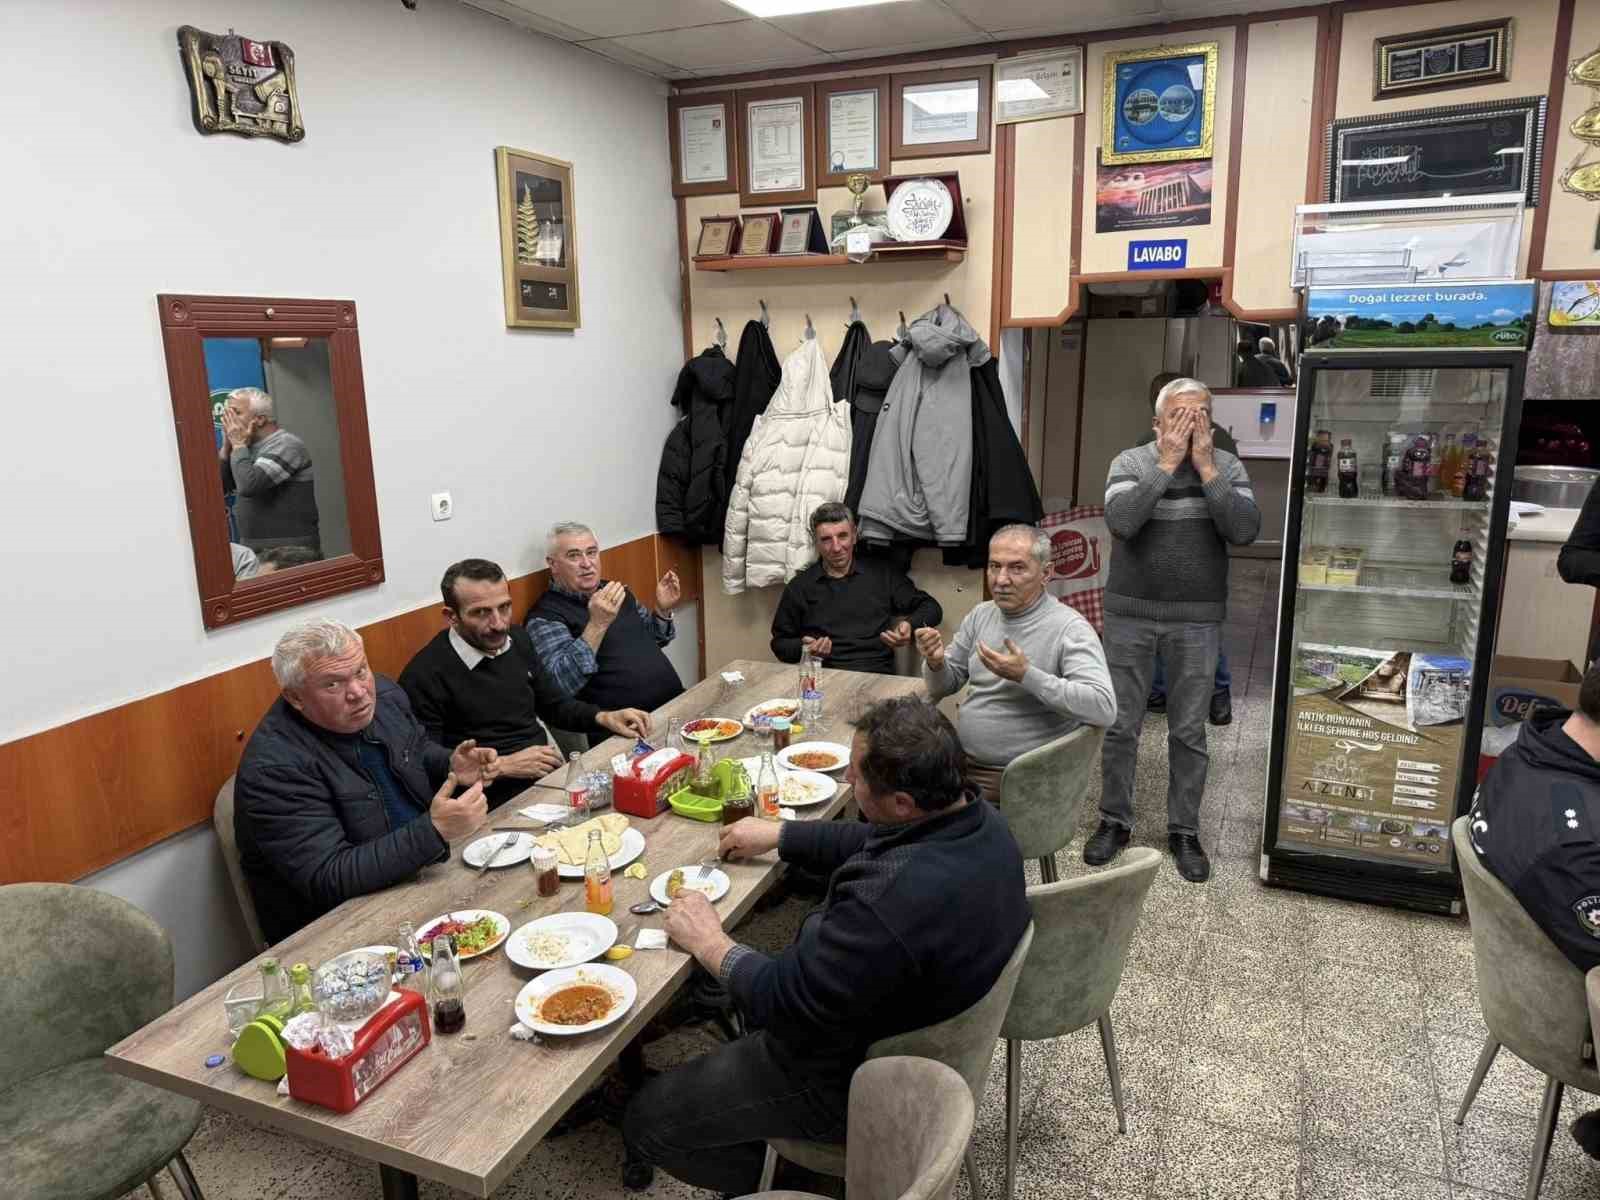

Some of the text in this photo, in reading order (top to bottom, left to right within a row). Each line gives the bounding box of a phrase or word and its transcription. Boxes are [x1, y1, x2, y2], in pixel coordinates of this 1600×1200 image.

[1133, 246, 1182, 263] LAVABO
[1348, 290, 1489, 305] Doğal lezzet burada.
